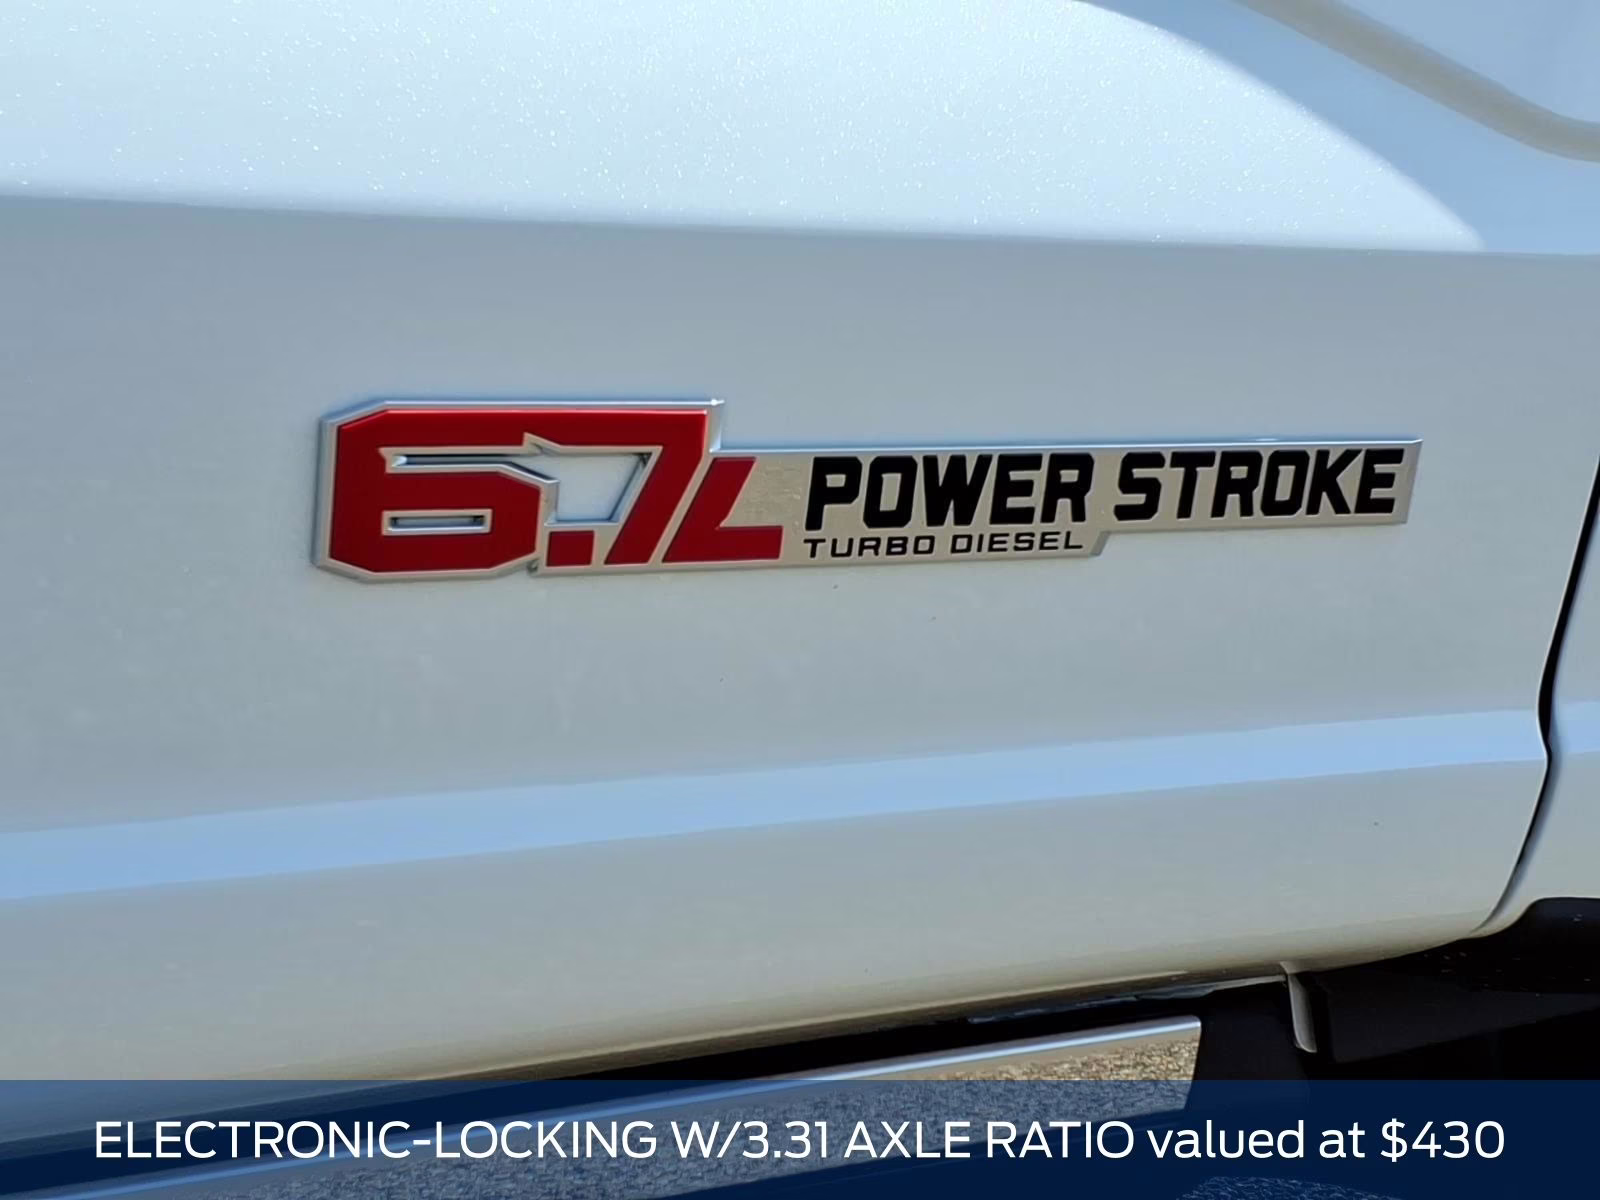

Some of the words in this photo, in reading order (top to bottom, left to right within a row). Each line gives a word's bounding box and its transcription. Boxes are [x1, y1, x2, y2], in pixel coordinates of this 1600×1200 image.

[329, 409, 783, 573] 6.7L
[804, 452, 1094, 531] POWER
[1113, 448, 1404, 521] STROKE
[803, 535, 935, 558] TURBO
[950, 531, 1083, 554] DIESEL
